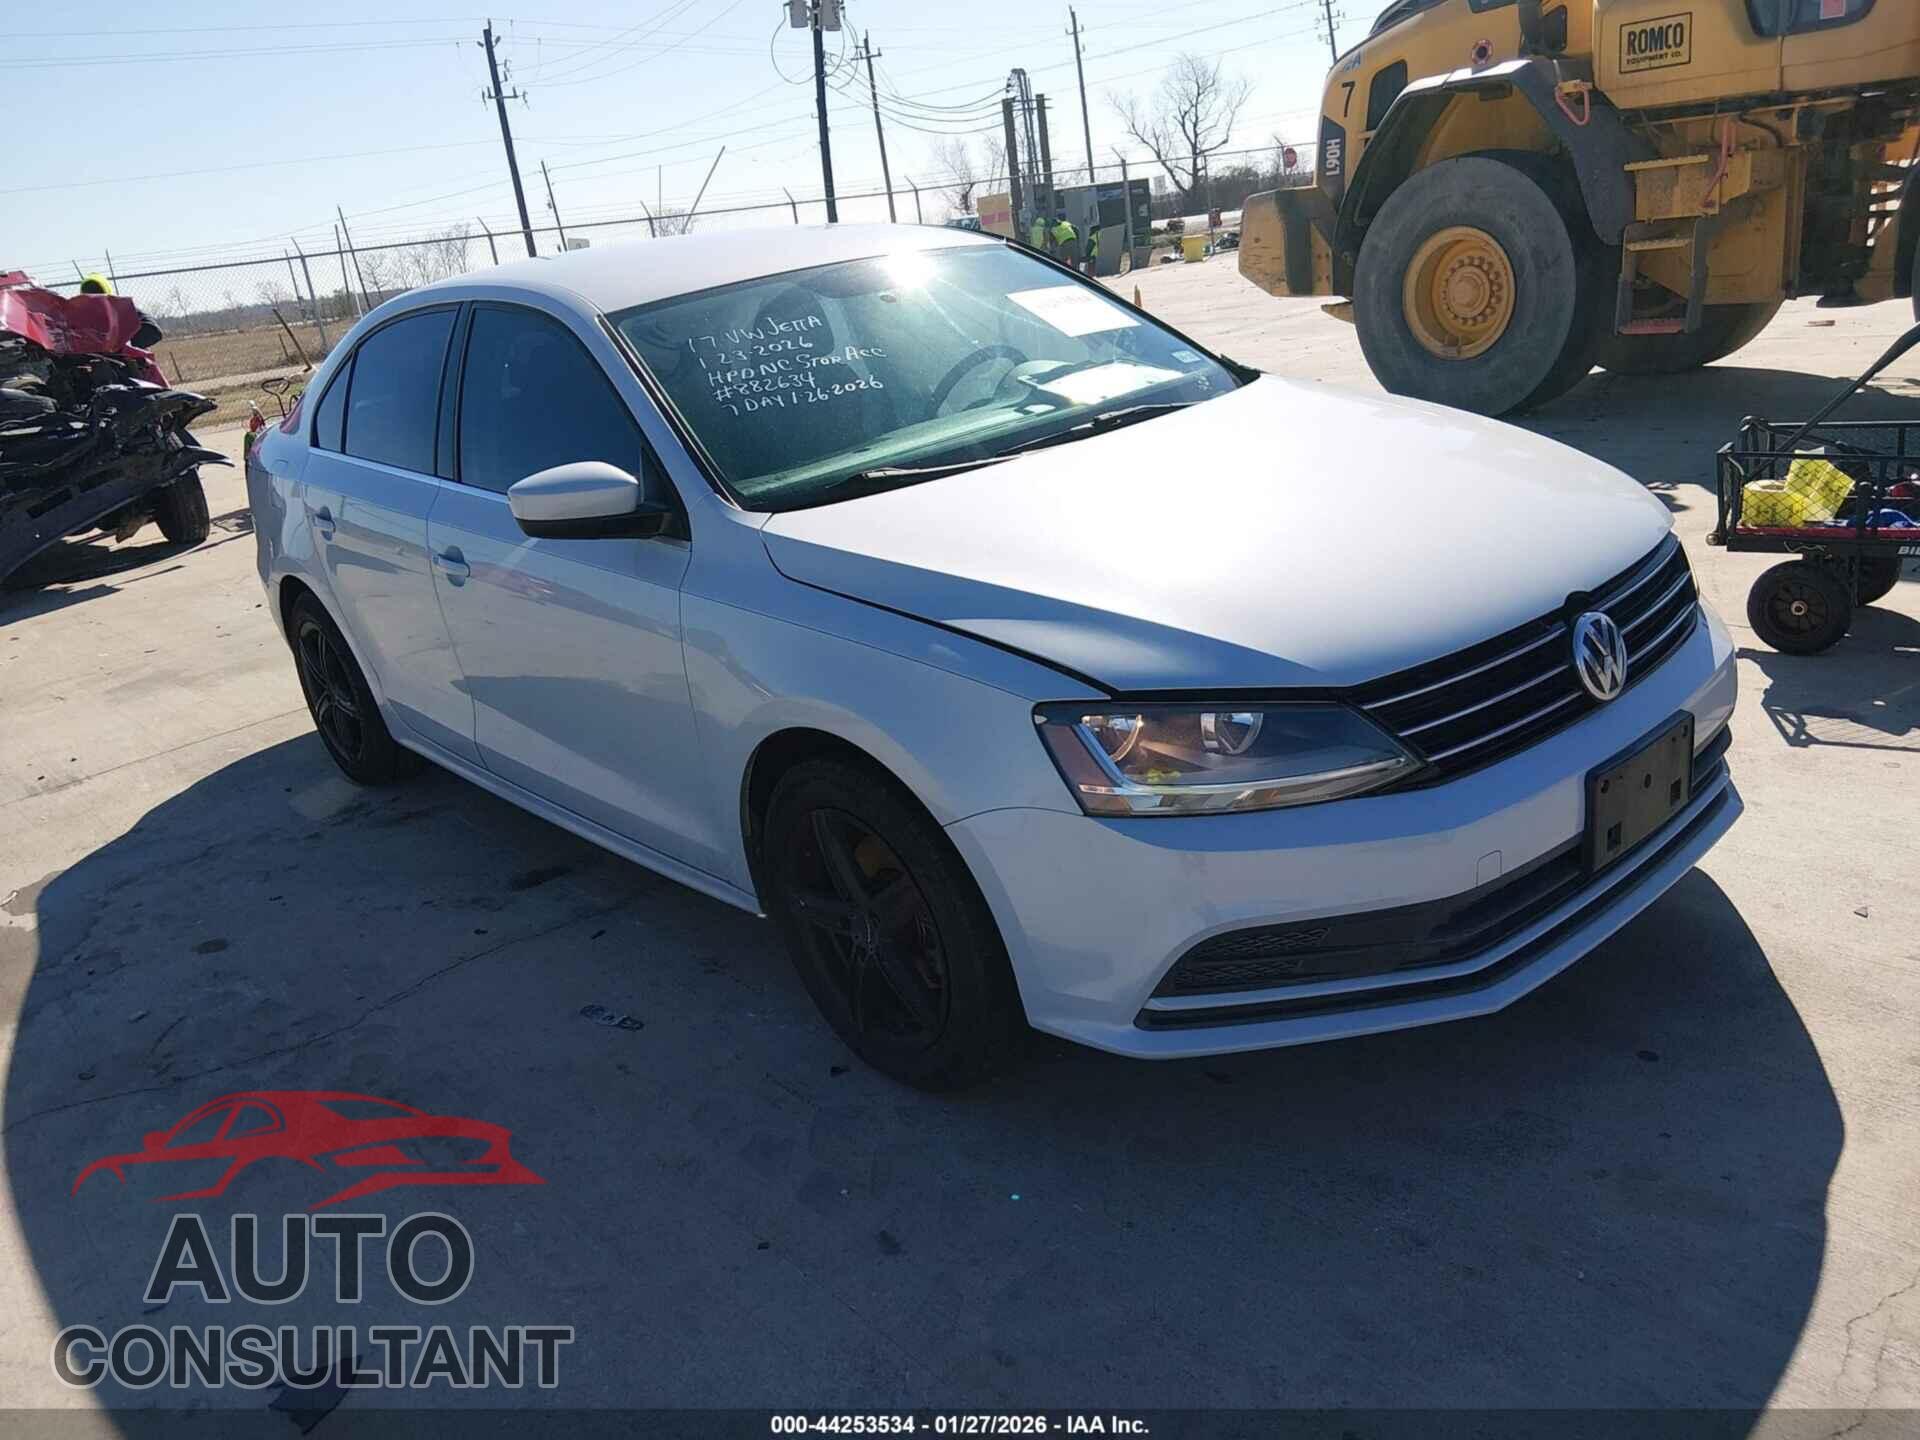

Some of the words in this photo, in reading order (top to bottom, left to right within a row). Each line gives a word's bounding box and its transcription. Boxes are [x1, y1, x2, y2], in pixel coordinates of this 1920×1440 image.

[1626, 22, 1684, 56] ROMCO
[1341, 81, 1356, 118] 7
[1325, 138, 1341, 176] L90H
[724, 328, 765, 344] VW
[712, 371, 817, 402] #882634
[744, 394, 785, 412] DAY
